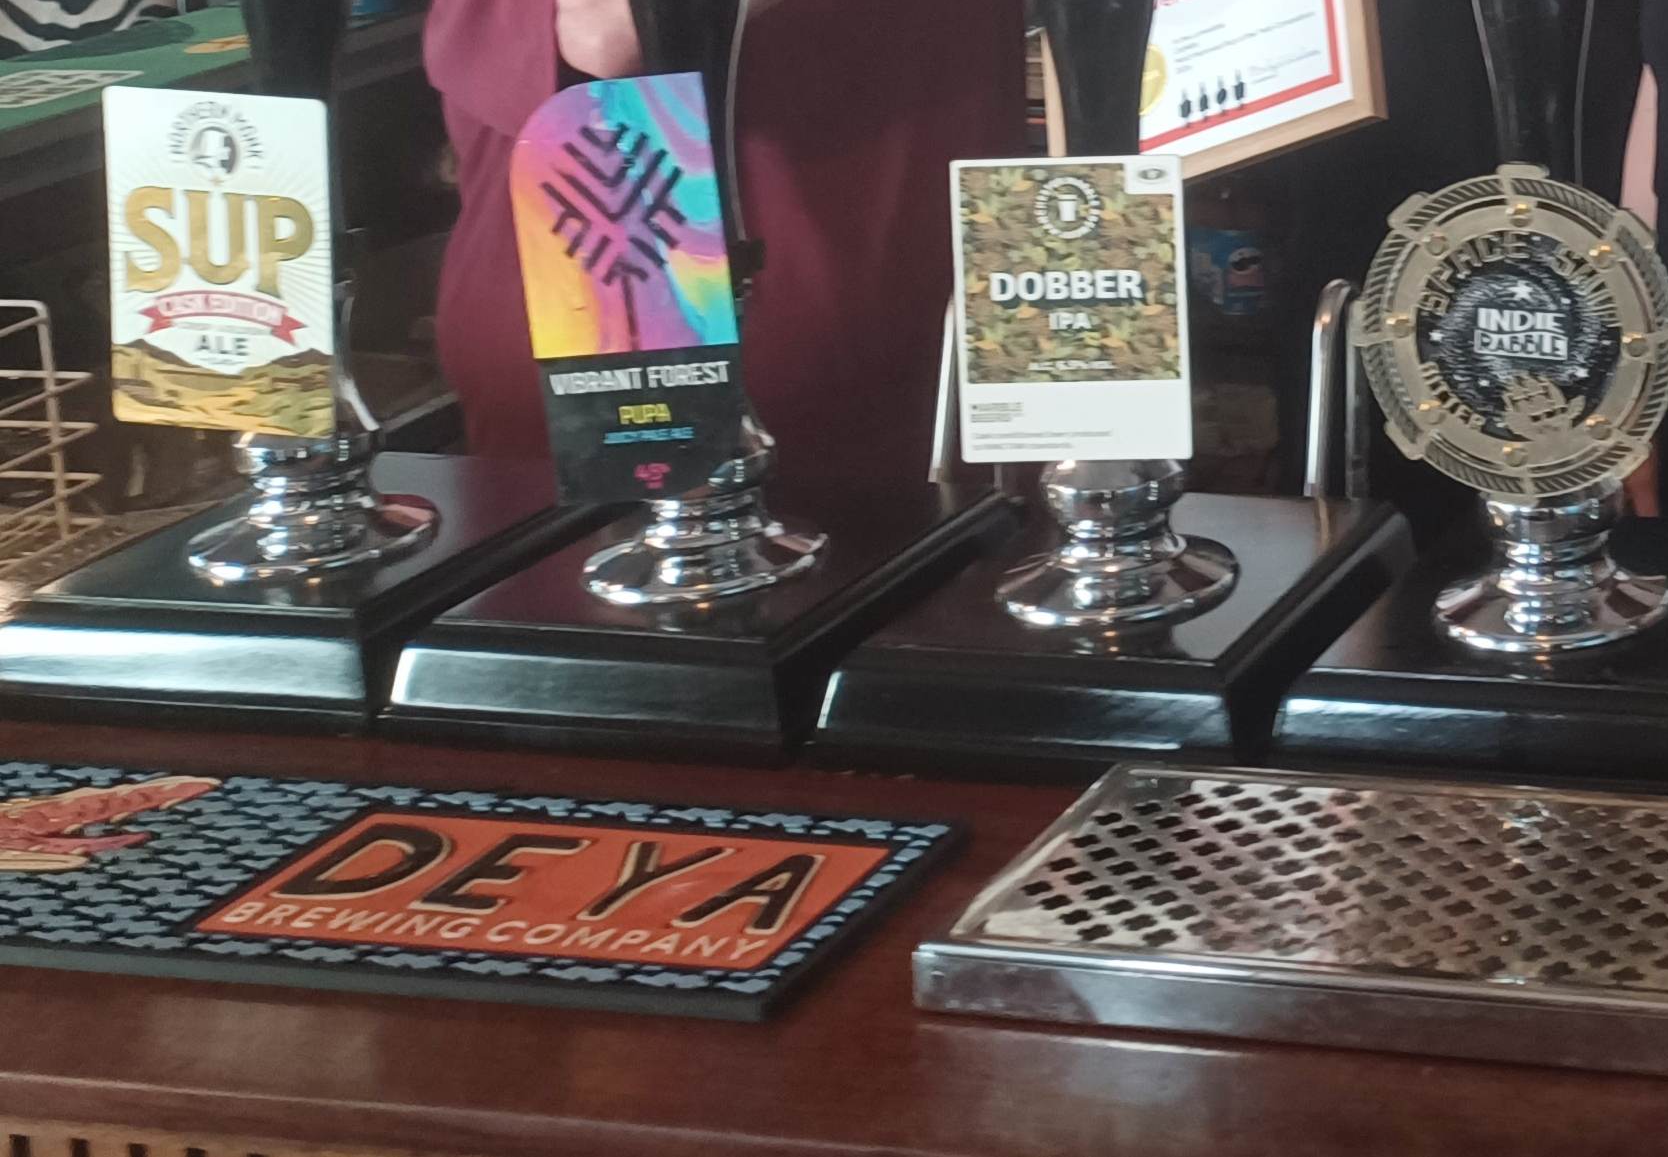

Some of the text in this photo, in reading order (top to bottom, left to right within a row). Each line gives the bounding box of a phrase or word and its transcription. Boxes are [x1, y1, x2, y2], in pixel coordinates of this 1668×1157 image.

[126, 185, 314, 297] SUP
[988, 269, 1144, 302] DOBBER
[1050, 312, 1095, 331] IPA
[1477, 307, 1567, 334] INDIE
[195, 335, 249, 357] ALE
[549, 359, 730, 395] VIBRANT FOREST
[270, 822, 828, 936] DEYA
[222, 901, 768, 960] BREWING COMPANY
